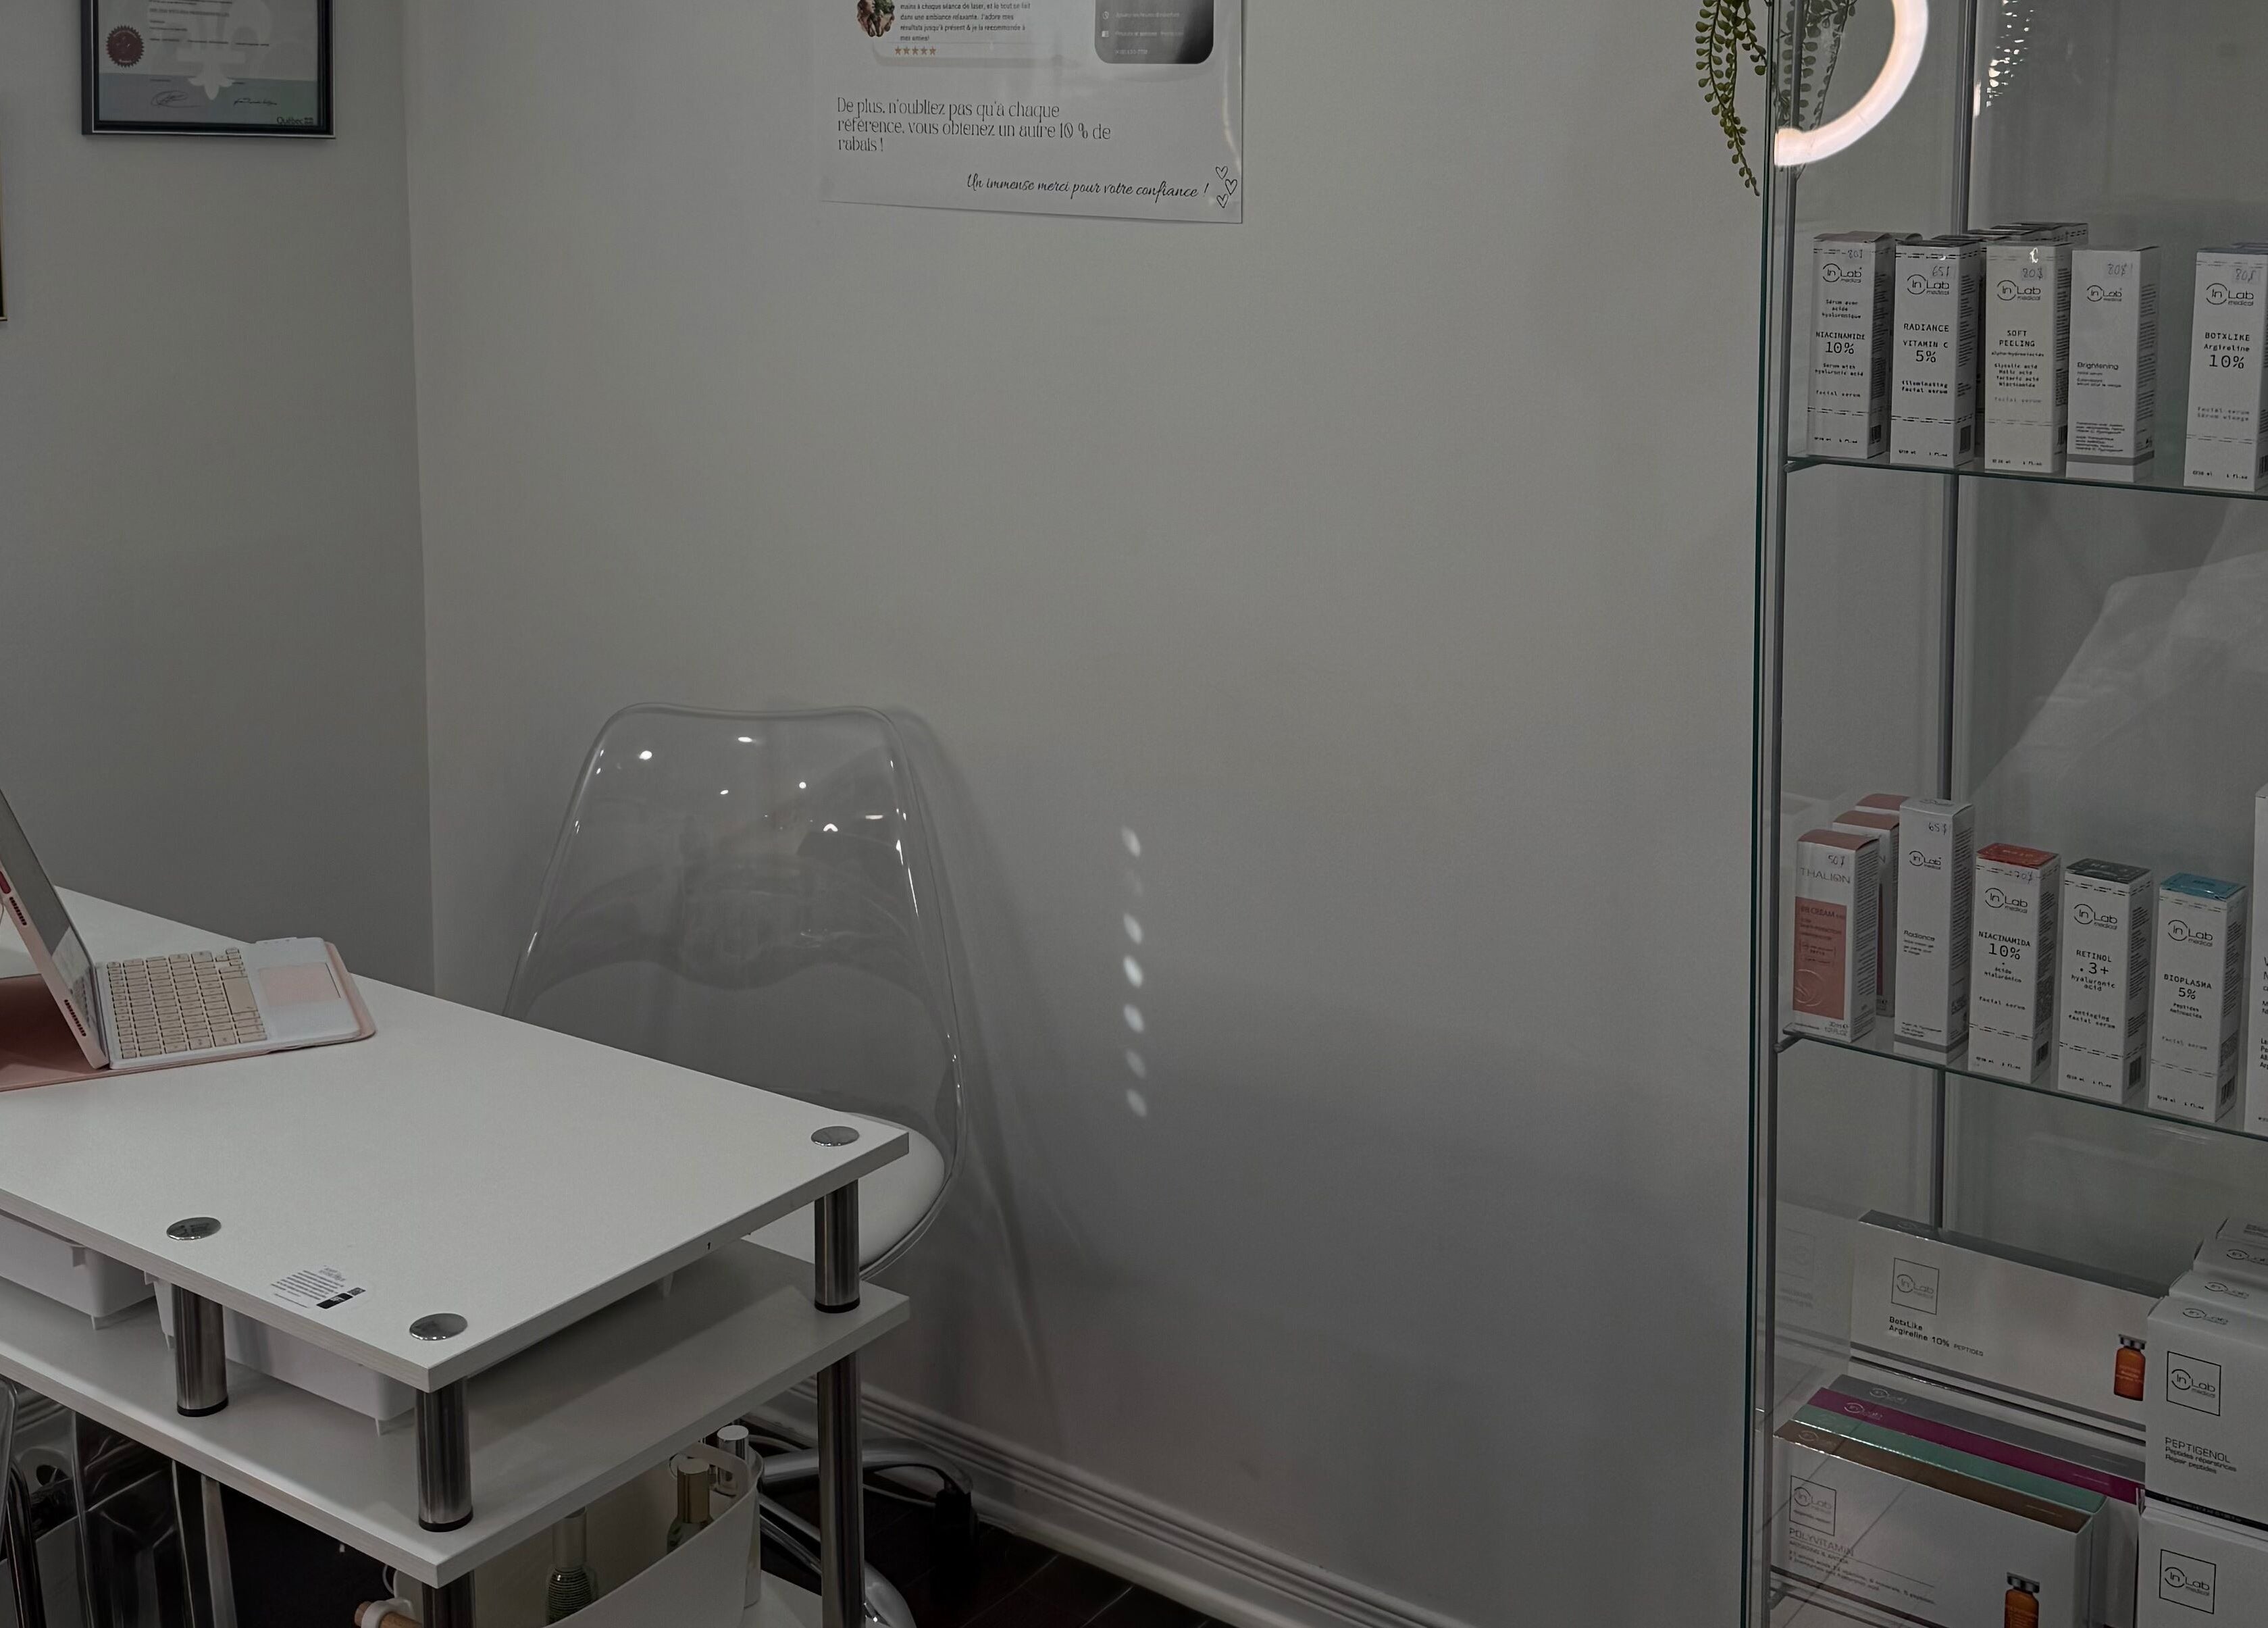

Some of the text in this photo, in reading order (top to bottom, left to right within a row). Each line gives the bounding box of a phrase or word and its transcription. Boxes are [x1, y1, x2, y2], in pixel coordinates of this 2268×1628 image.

[837, 97, 854, 112] De
[889, 99, 946, 115] n'oubliez
[949, 103, 973, 121] pas
[977, 101, 1004, 122] qu'à
[1008, 101, 1060, 123] chaque
[908, 122, 939, 134] vous
[942, 120, 996, 136] obtenez
[999, 124, 1015, 136] un
[1019, 124, 1056, 138] autre
[1060, 122, 1074, 138] 10
[1078, 122, 1088, 139] %
[1092, 124, 1111, 139] de
[838, 136, 877, 152] rabais
[967, 173, 984, 191] Un
[986, 178, 1035, 191] immense
[1037, 181, 1070, 192] merci
[1070, 183, 1101, 199] pour
[1104, 182, 1133, 195] votre
[1136, 180, 1199, 203] confiance
[1840, 270, 1862, 278] Lab
[1926, 280, 1950, 289] Lab
[2017, 286, 2041, 295] Lab
[2228, 290, 2254, 300] Lab
[1904, 323, 1949, 332] RADIANCE
[1815, 331, 1865, 340] NIACINAMIDE
[2205, 332, 2250, 342] BOTXLIKE
[1825, 341, 1854, 355] 10%
[1903, 340, 1938, 348] VITAMIN
[1915, 350, 1937, 363] 5%
[2209, 355, 2244, 369] 10%
[2077, 361, 2119, 371] Brightening
[1799, 867, 1851, 884] THALION
[2005, 895, 2028, 908] Lab
[2094, 912, 2117, 924] Lab
[1904, 930, 1935, 942] Radiance
[1978, 931, 2031, 947] NIACINAMIDA
[2188, 928, 2213, 941] Lab
[1988, 943, 2020, 960] 10%
[2076, 949, 2111, 963] RETINOL
[2071, 974, 2115, 988] hyaluronic
[2084, 984, 2103, 992] acid
[2164, 973, 2212, 990] BIOPLASMA
[2178, 987, 2196, 1000] 5%
[1913, 1281, 1935, 1294] Lab
[1889, 1316, 1923, 1331] BotxLike
[1889, 1325, 1928, 1341] Argireline
[1932, 1336, 1950, 1347] 10%
[2191, 1378, 2216, 1392] Lab
[2165, 1437, 2231, 1464] PEPTIGENOL
[2188, 1461, 2217, 1475] peptides
[2186, 1576, 2210, 1591] Lab
